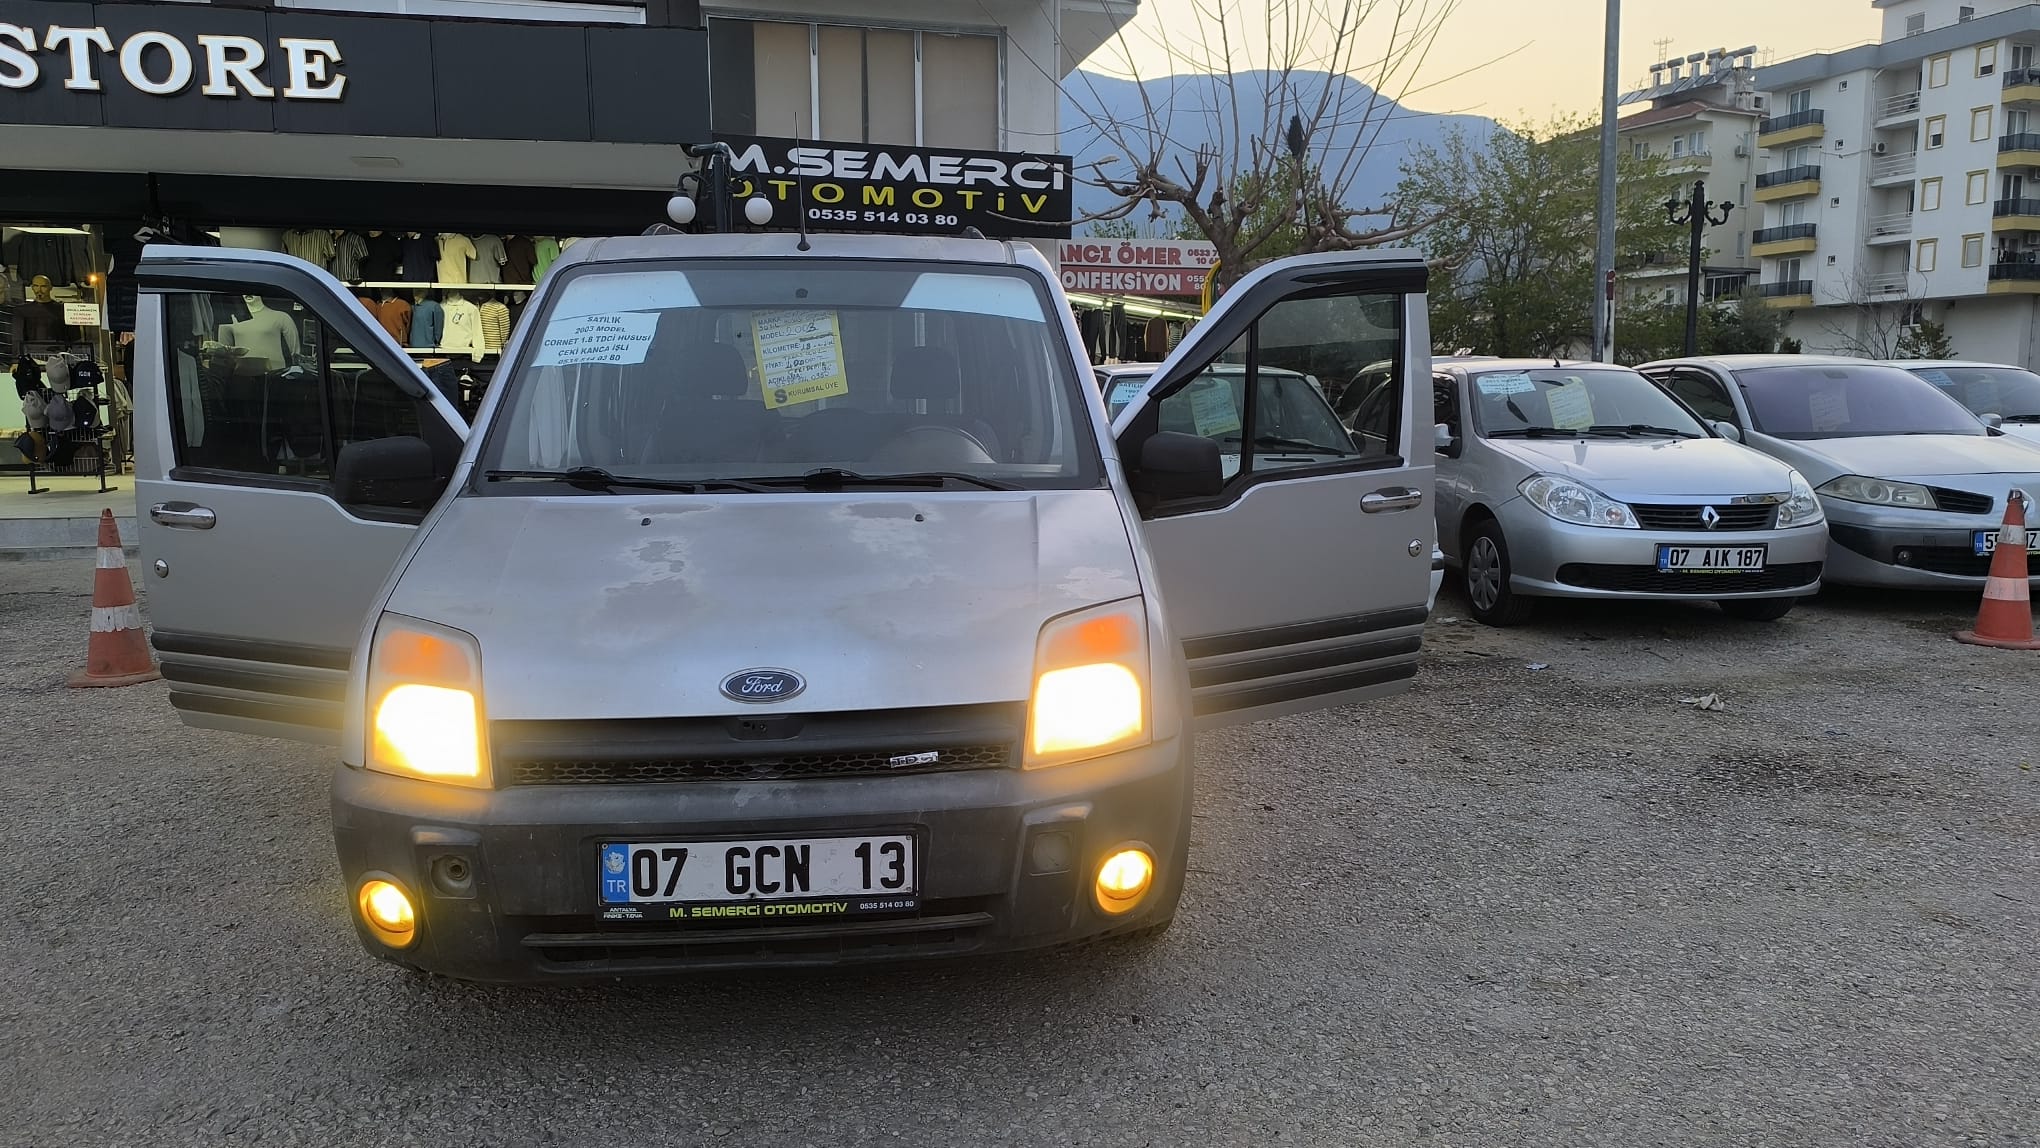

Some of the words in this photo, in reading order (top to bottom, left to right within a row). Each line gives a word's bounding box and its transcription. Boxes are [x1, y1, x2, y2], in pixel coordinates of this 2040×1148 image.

[0, 22, 347, 100] STORE
[808, 208, 857, 221] 0535
[864, 209, 899, 223] 514
[905, 211, 928, 224] 03
[934, 212, 958, 226] 80
[1117, 242, 1182, 265] ÖMER
[587, 316, 622, 324] SATILIK
[575, 326, 594, 334] 2003
[544, 337, 579, 347] CORNET
[582, 336, 593, 344] 1.8
[581, 346, 609, 356] KANCA
[788, 384, 824, 397] KURUMSAL
[1669, 549, 1690, 566] 07
[1702, 549, 1731, 567] AIK
[1737, 549, 1763, 567] 187
[741, 675, 784, 694] Ford
[631, 847, 688, 898] 07
[725, 844, 811, 894] GCN
[854, 841, 906, 889] 13
[606, 879, 627, 893] TR
[859, 902, 878, 910] 0535
[879, 901, 893, 909] 514
[905, 900, 915, 908] 80
[669, 907, 688, 918] M.
